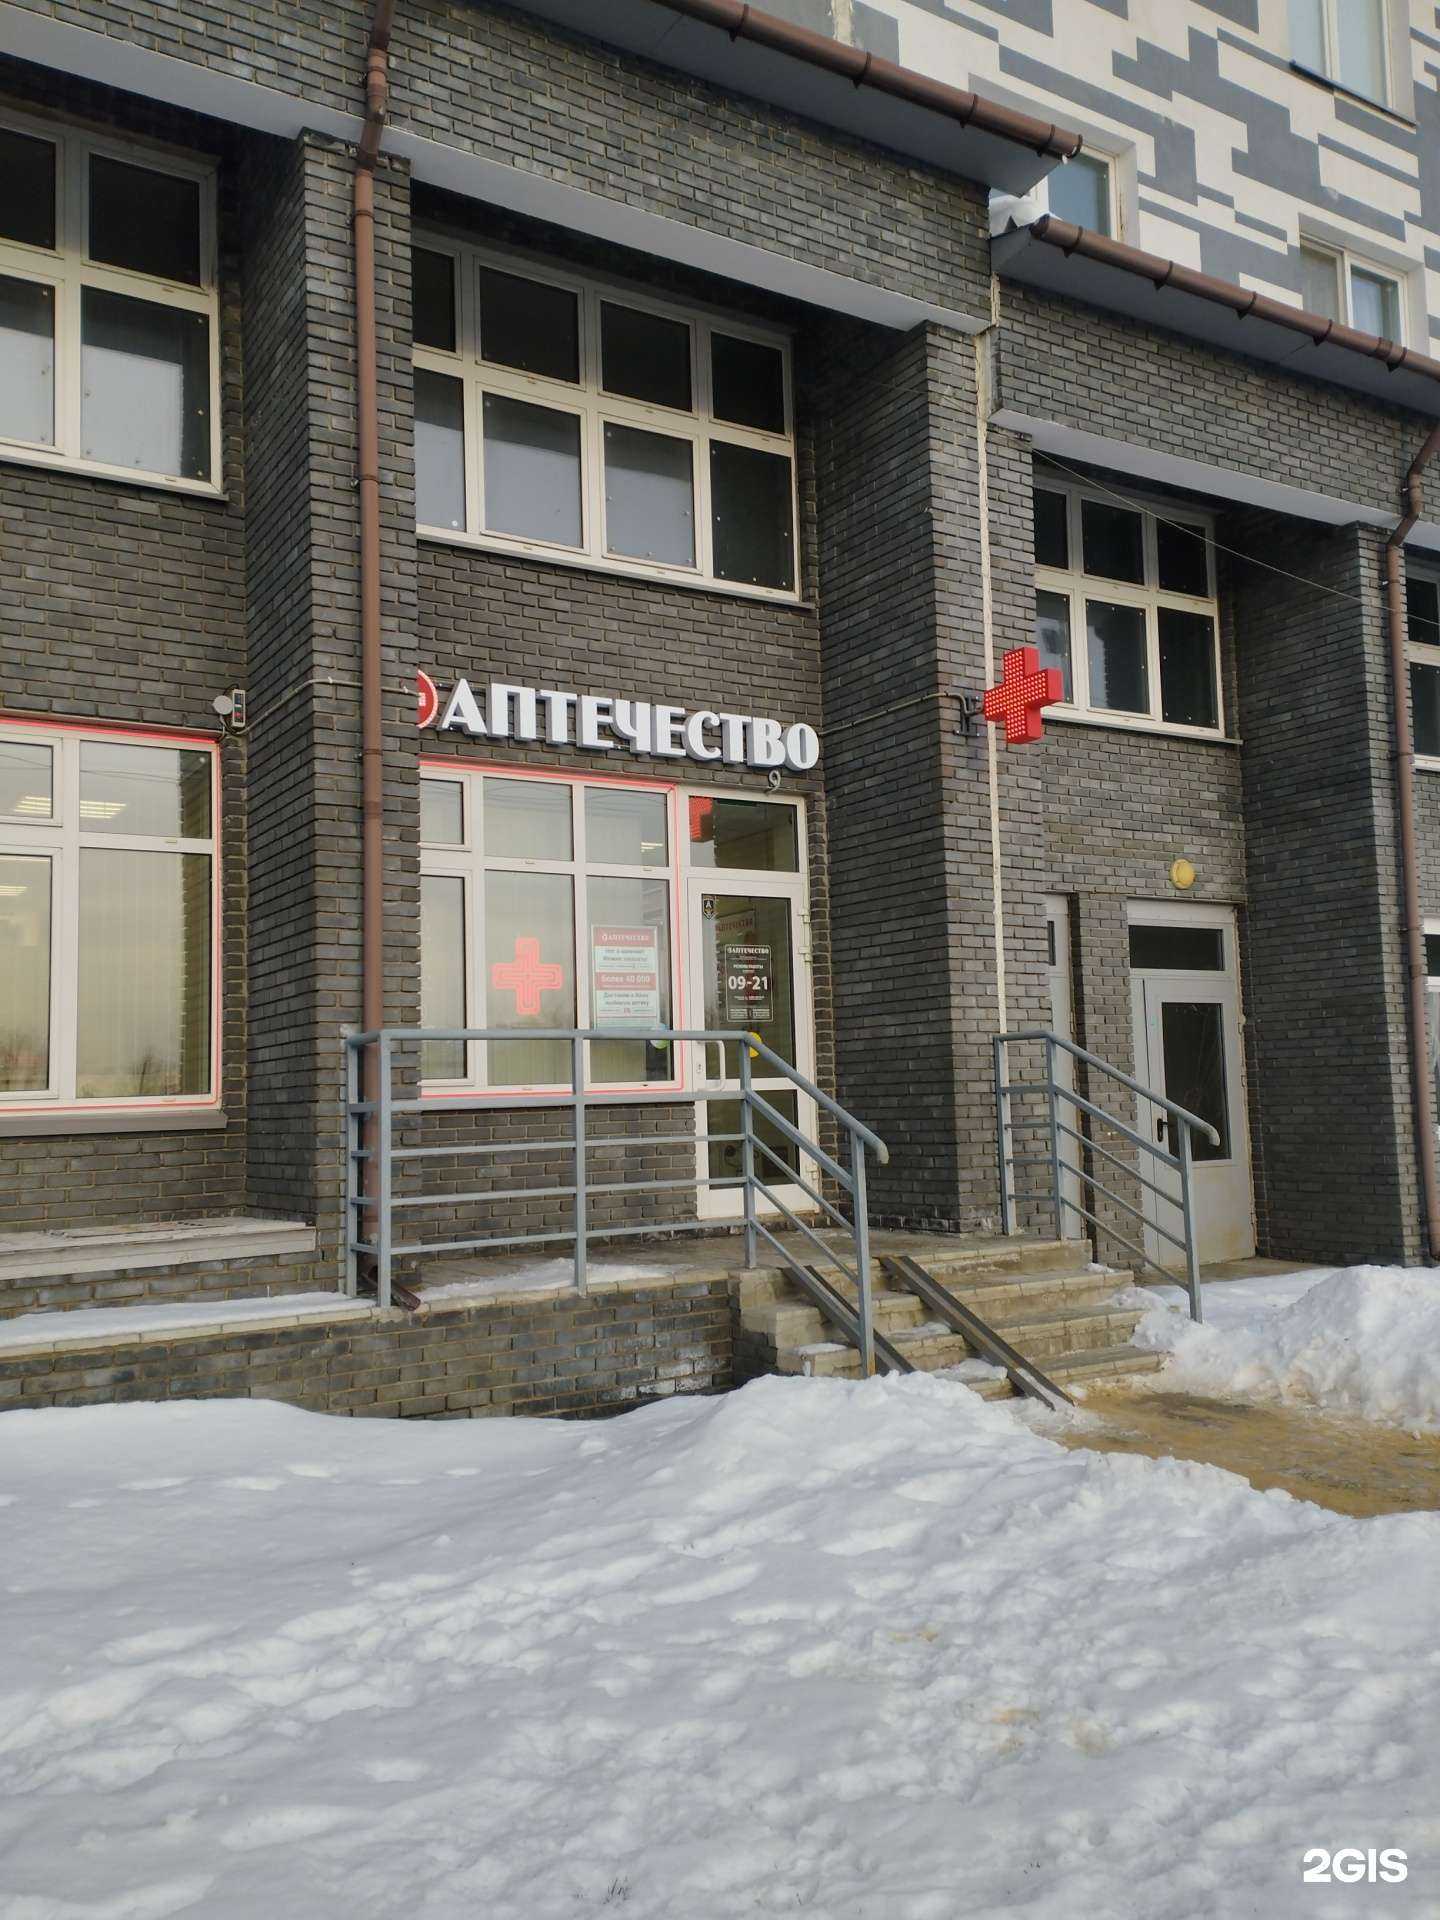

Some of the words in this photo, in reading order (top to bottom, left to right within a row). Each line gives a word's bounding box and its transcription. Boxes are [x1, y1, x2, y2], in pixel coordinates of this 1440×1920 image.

[437, 678, 820, 771] АПТЕЧЕСТВО
[730, 946, 769, 954] АПТЕЧЕСТВО
[728, 975, 768, 991] 09-21
